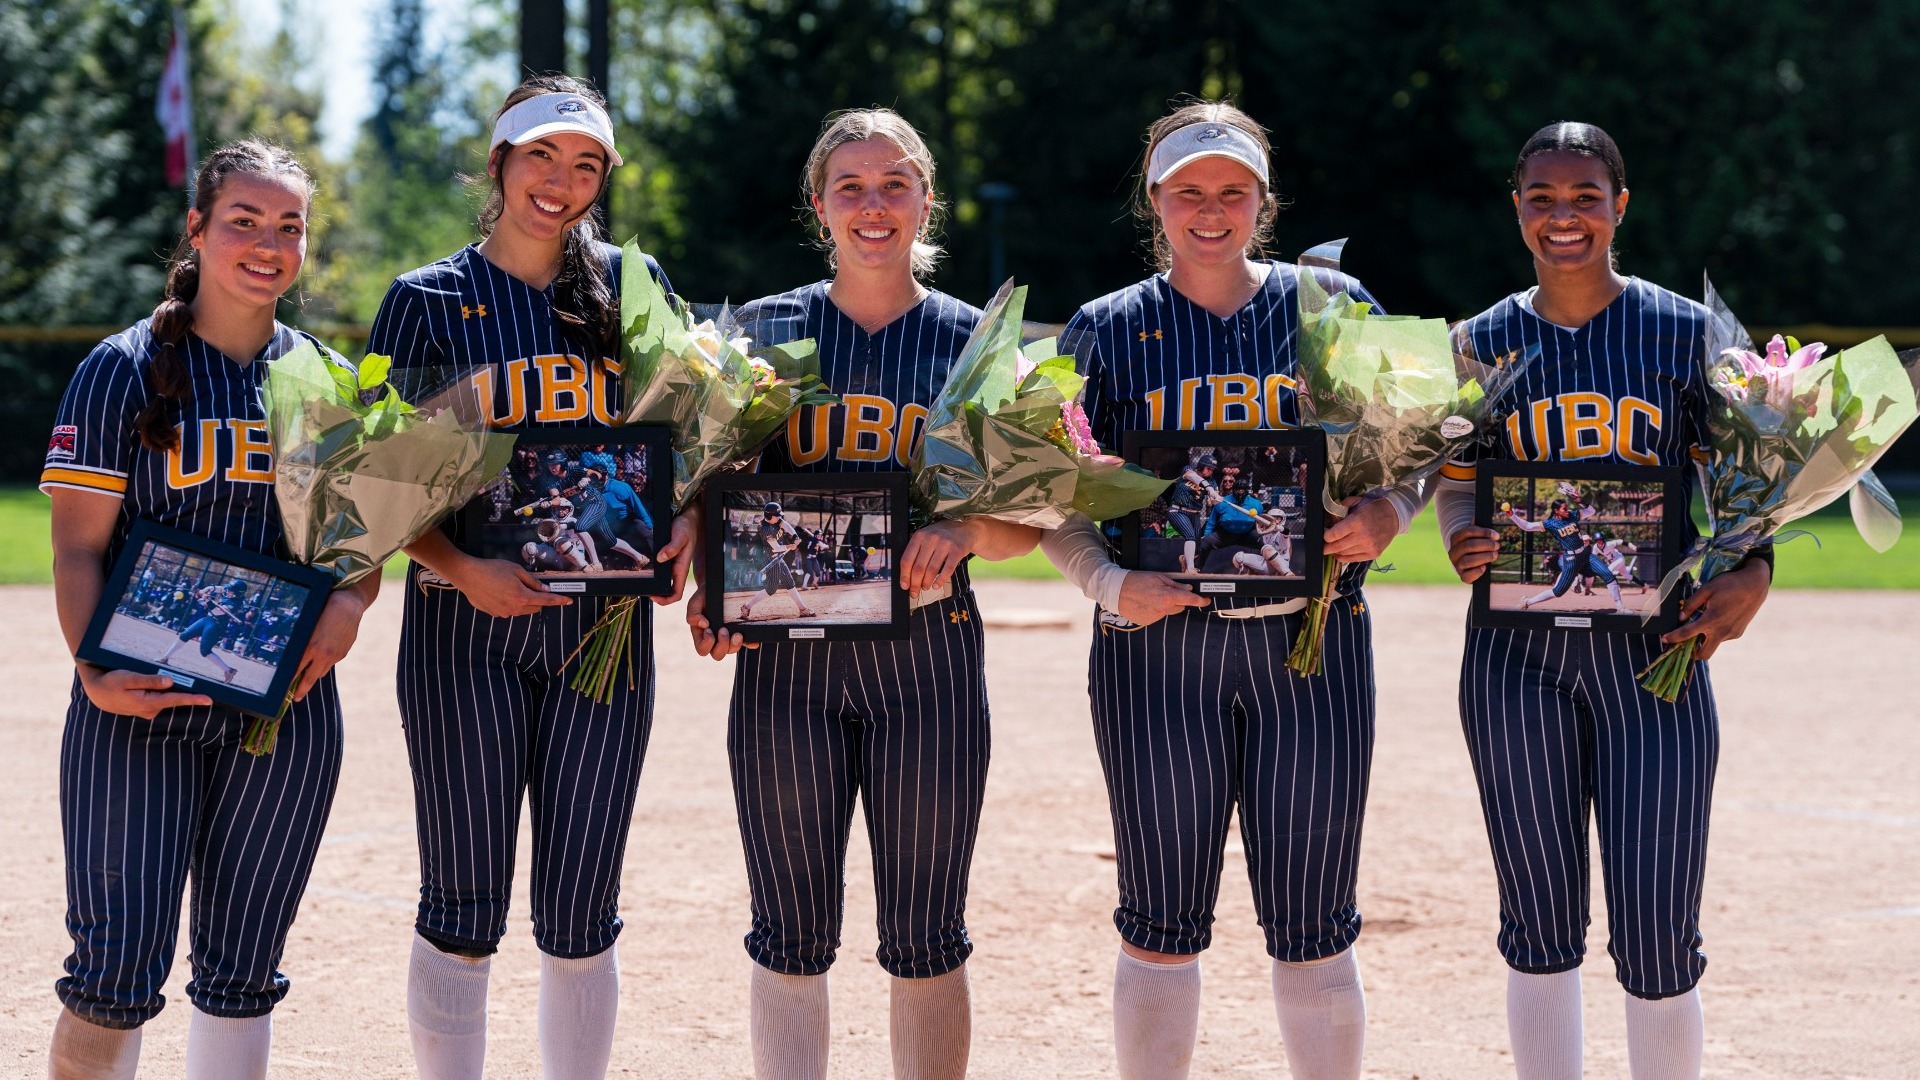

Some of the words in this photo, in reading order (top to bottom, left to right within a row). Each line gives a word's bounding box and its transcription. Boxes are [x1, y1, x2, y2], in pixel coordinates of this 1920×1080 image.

[472, 354, 626, 427] UBC
[1145, 373, 1300, 430] UBC
[1506, 392, 1662, 466] UBC
[1558, 523, 1579, 537] UBC
